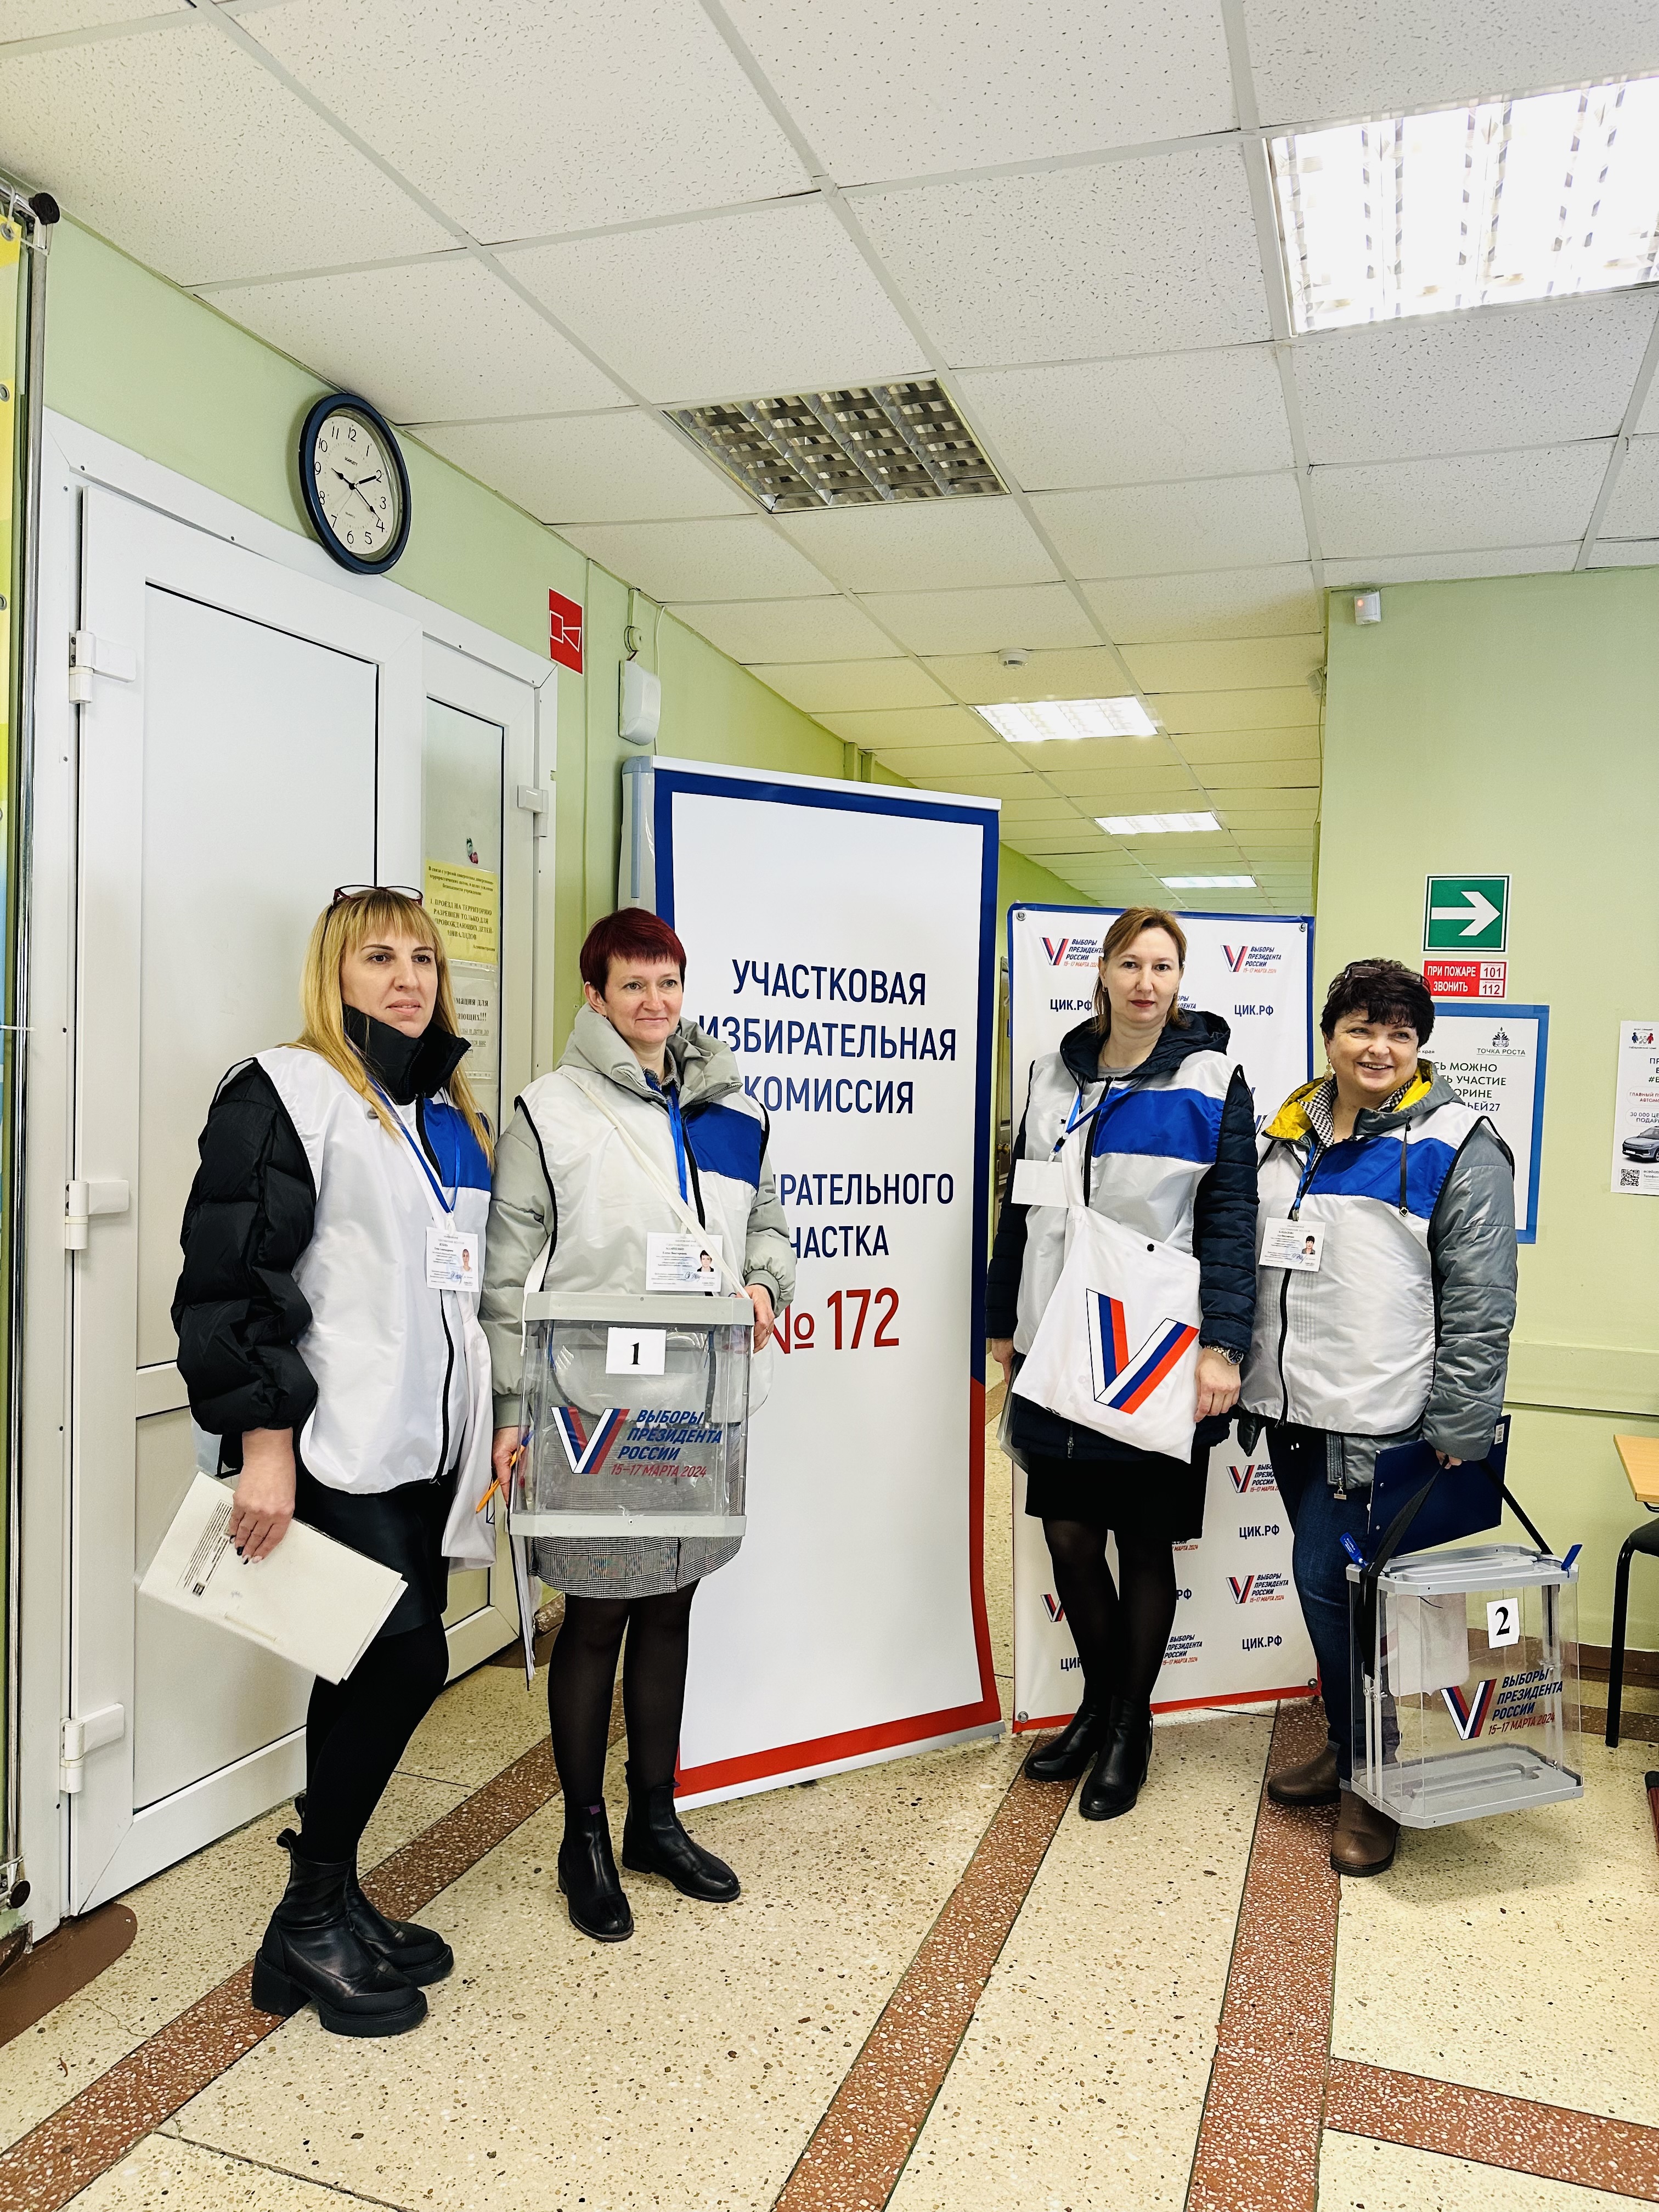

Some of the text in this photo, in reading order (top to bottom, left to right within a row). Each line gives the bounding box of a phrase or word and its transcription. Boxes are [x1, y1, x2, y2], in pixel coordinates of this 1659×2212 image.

[332, 426, 339, 439] 11
[348, 427, 357, 442] 12
[318, 438, 328, 452] 10
[314, 462, 321, 475] 9
[319, 491, 325, 505] 8
[380, 496, 386, 509] 3
[331, 515, 337, 528] 7
[347, 531, 354, 544] 6
[365, 532, 372, 545] 5
[435, 899, 453, 909] ПРОЕЗД
[462, 904, 492, 916] ТЕРРИТОРИЮ
[433, 909, 460, 918] РАЗРЕШЕН
[461, 913, 479, 922] ТОЛЬКО
[435, 918, 477, 931] ПРОВОЖДАЮЩИХ
[1427, 966, 1476, 977] ПРИ ПОЖАРЕ
[1484, 967, 1501, 978] 101
[732, 959, 926, 1006] УЧАСТКОВАЯ
[1434, 981, 1468, 992] ЗВОНИТЬ
[1482, 984, 1500, 995] 112
[455, 997, 476, 1006] мация
[1050, 999, 1092, 1012] ЦИК.РФ
[457, 1012, 487, 1022] ающих!!!
[1234, 1005, 1273, 1017] ЦИК.РФ
[699, 1015, 956, 1060] ИЗБИРАТЕЛЬНАЯ
[1450, 1062, 1497, 1072] МОЖНО
[1456, 1075, 1506, 1086] УЧАСТИЕ
[744, 1076, 913, 1114] КОМИССИЯ
[773, 1173, 954, 1206] РАТЕЛЬНОГО
[772, 1287, 899, 1354] № 172
[630, 1342, 640, 1366] 1
[636, 1409, 704, 1425] ВЫБОРЫ
[627, 1427, 723, 1444] ПРЕЗИДЕНТА
[618, 1446, 681, 1460] РОССИИ
[642, 1465, 679, 1477] МАРТА
[680, 1465, 707, 1477] 2024
[1239, 1524, 1280, 1540] ЦИК.РФ
[1254, 1580, 1289, 1588] ПРЕЗИДЕНТА
[1176, 1588, 1192, 1600] РФ
[1495, 1606, 1511, 1636] 2
[1170, 1634, 1195, 1643] ВЫБОРЫ
[1242, 1635, 1282, 1651] ЦИК.РФ
[1167, 1641, 1202, 1650] ПРЕЗИДЕНТА
[1502, 1668, 1550, 1689] ВЫБОРЫ
[1497, 1681, 1562, 1705] ПРЕЗИДЕНТА
[1492, 1702, 1536, 1721] РОССИИ
[1510, 1717, 1536, 1731] МАРТА
[1536, 1713, 1555, 1725] 2024
